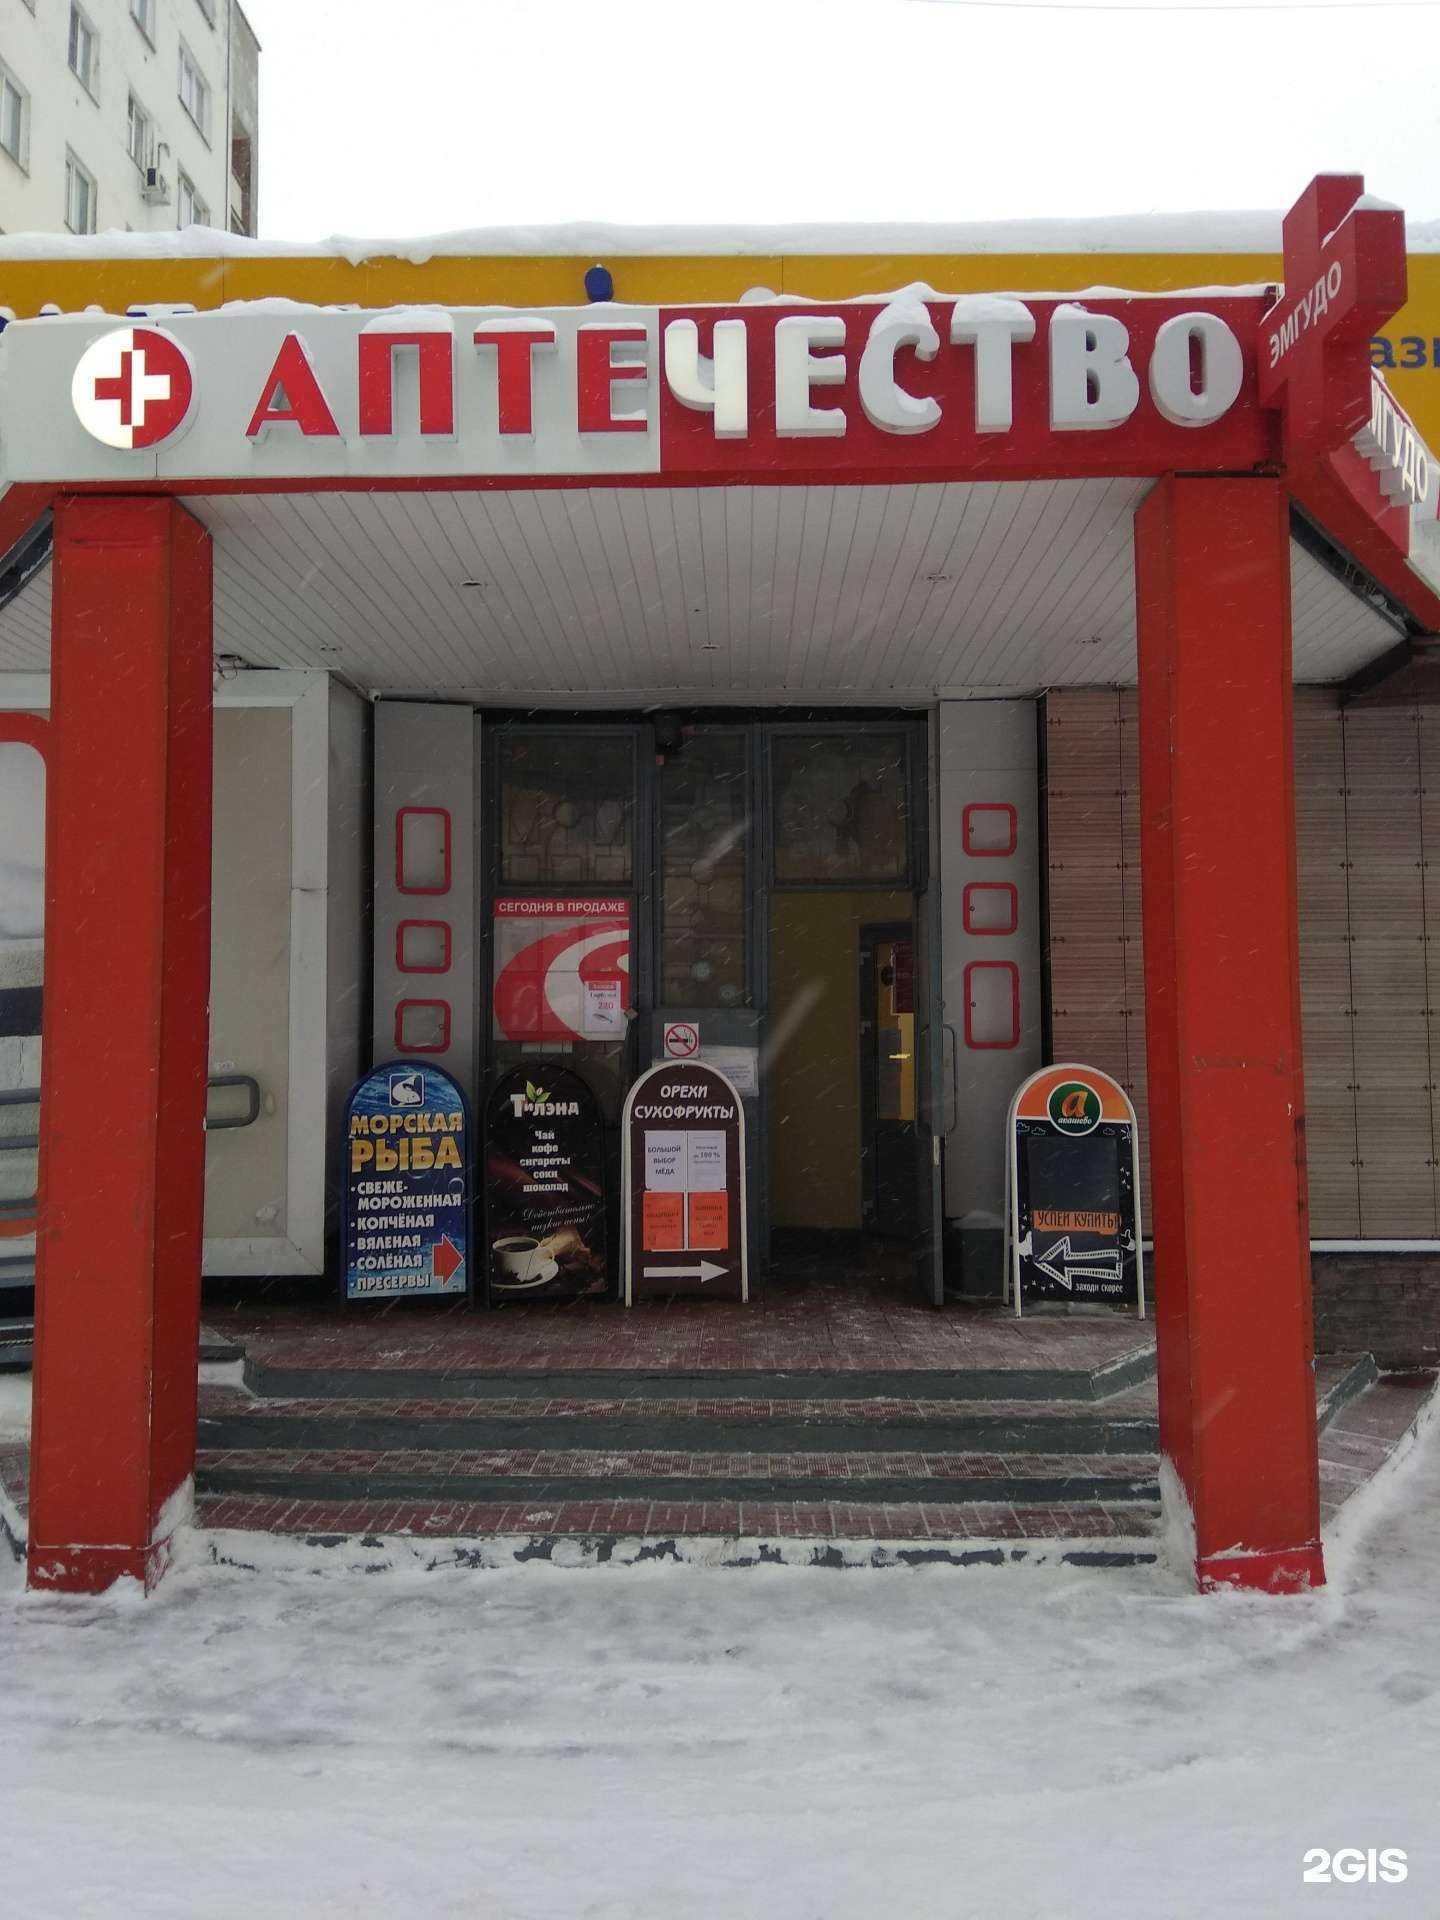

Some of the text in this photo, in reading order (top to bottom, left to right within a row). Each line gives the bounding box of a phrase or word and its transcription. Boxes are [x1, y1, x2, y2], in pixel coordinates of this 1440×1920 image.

[1270, 261, 1342, 368] ЭМГУДО
[499, 902, 625, 914] СЕГОДНЯ В ПРОДАЖЕ
[660, 1085, 708, 1099] ОРЕХИ
[634, 1105, 734, 1120] СУХОФРУКТЫ
[351, 1112, 464, 1136] МОРСКАЯ
[534, 1130, 555, 1140] Чай
[351, 1137, 463, 1173] РЫБА
[531, 1143, 559, 1154] кофе
[647, 1144, 681, 1153] БОЛЬШОЙ
[519, 1157, 571, 1168] сигареты
[533, 1170, 558, 1179] соки
[357, 1180, 408, 1195] СВЕЖЕ-
[522, 1183, 569, 1193] шоколад
[357, 1193, 462, 1211] МОРОЖЕННАЯ
[357, 1213, 435, 1231] КОПЧЁНАЯ
[357, 1234, 421, 1251] ВЯЛЕНАЯ
[357, 1252, 423, 1270] СОЛЁНАЯ
[357, 1274, 431, 1292] ПРЕСЕРВЫ
